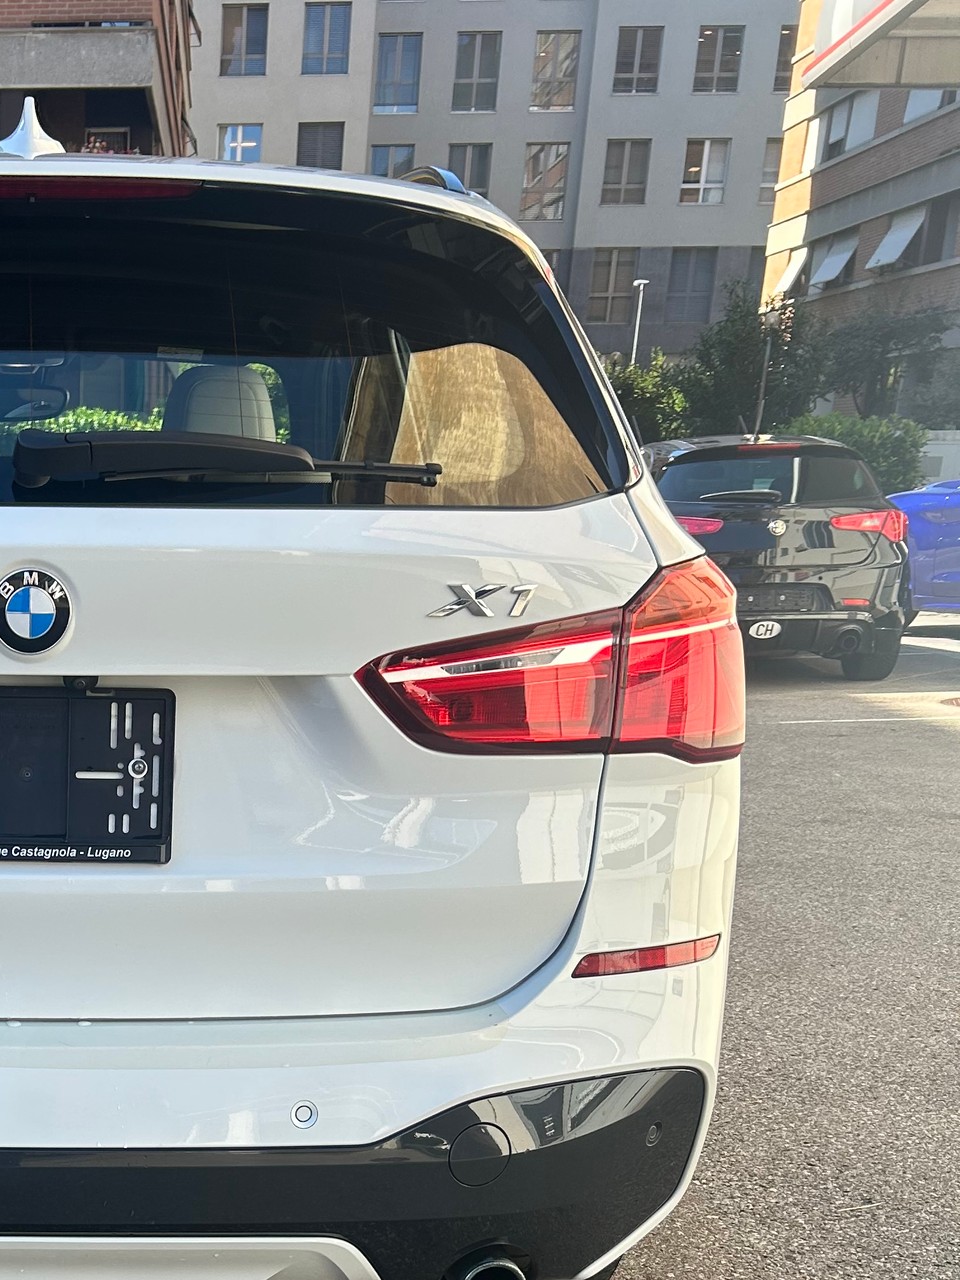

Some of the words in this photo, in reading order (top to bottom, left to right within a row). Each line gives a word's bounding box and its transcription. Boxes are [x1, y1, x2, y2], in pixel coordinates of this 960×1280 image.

[426, 584, 538, 617] X1
[755, 623, 775, 637] CH
[11, 846, 77, 859] Castagnola
[87, 847, 131, 860] Lugano
